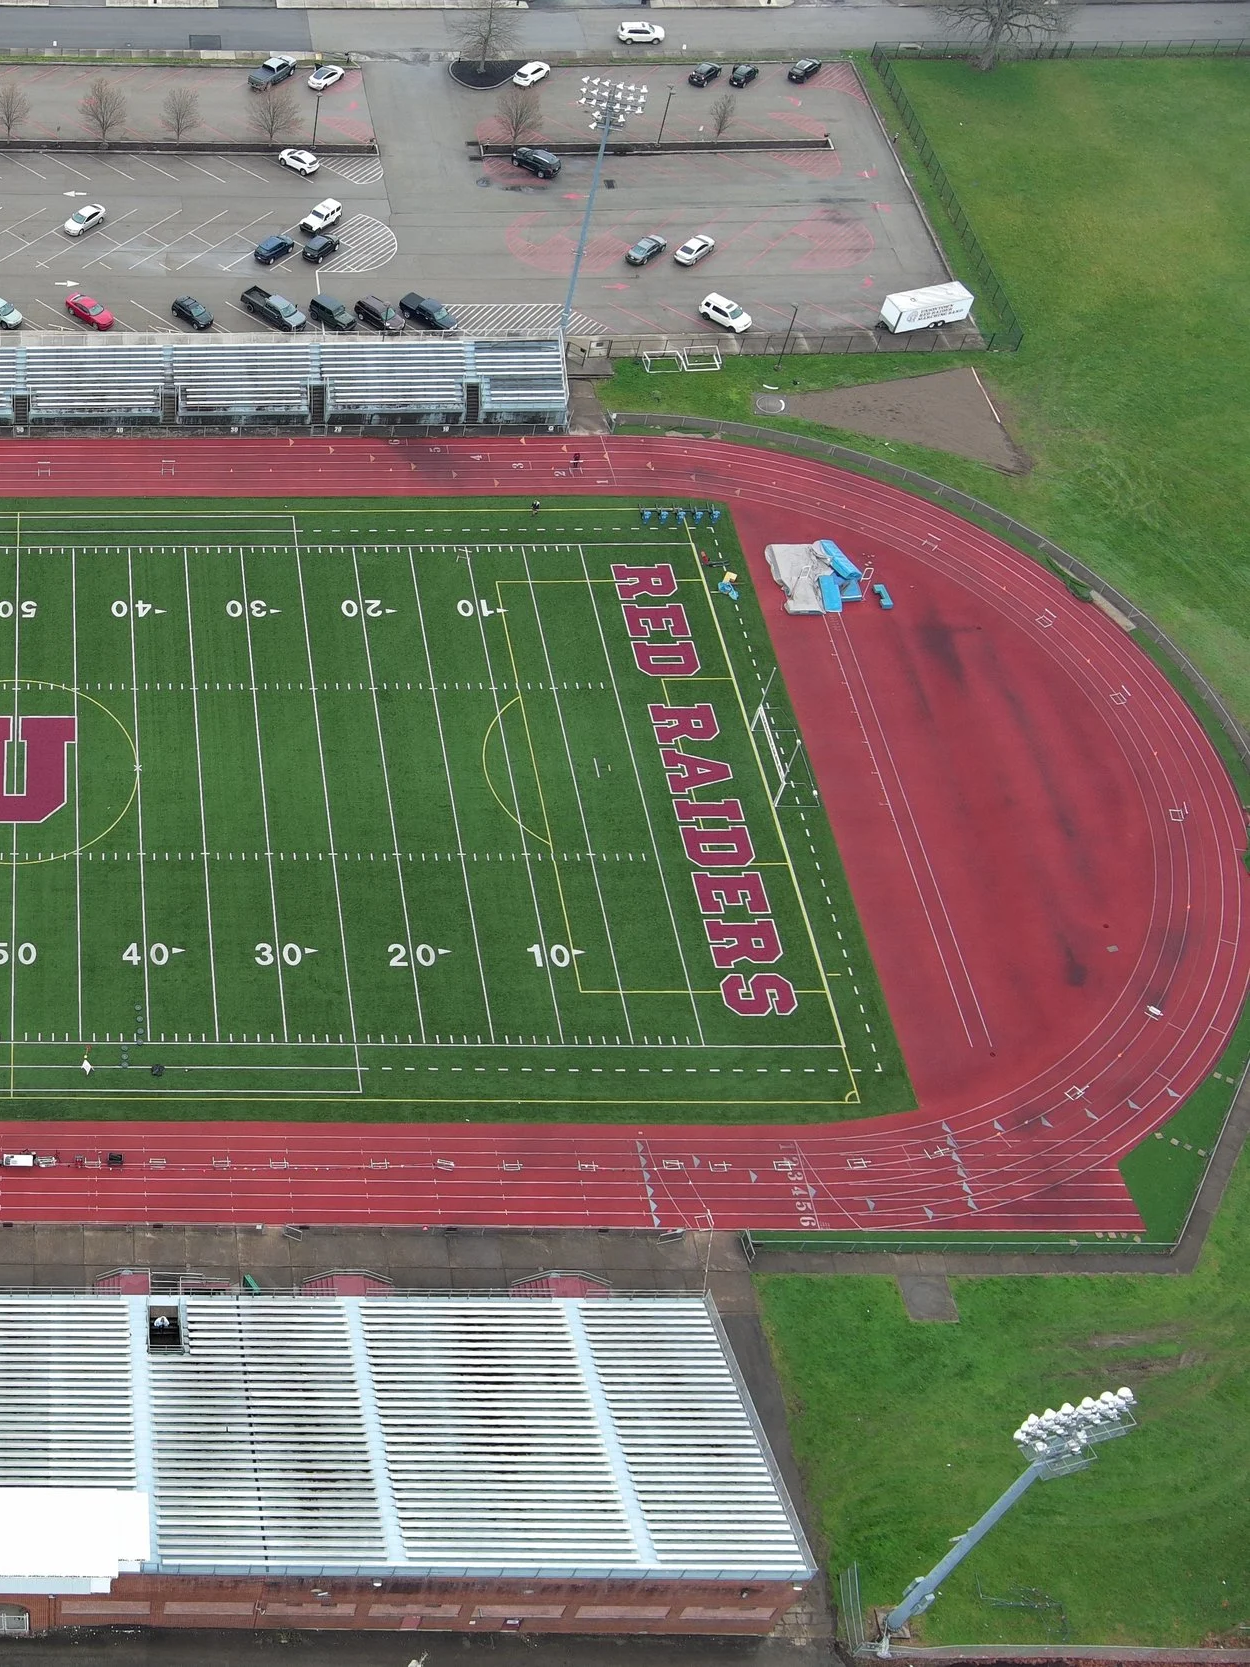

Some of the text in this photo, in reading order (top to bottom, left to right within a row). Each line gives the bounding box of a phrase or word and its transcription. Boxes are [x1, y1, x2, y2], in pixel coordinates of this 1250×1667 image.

[110, 600, 152, 618] 40
[225, 600, 267, 618] 30
[341, 599, 382, 618] 20
[456, 599, 495, 618] 10
[610, 563, 798, 1017] RED RAIDERS
[121, 941, 169, 966] 40
[254, 941, 302, 966] 30
[386, 942, 436, 967] 20
[527, 944, 570, 967] 10
[787, 1171, 803, 1181] 3
[791, 1186, 808, 1196] 4
[795, 1201, 812, 1211] 5
[800, 1216, 816, 1226] 6
